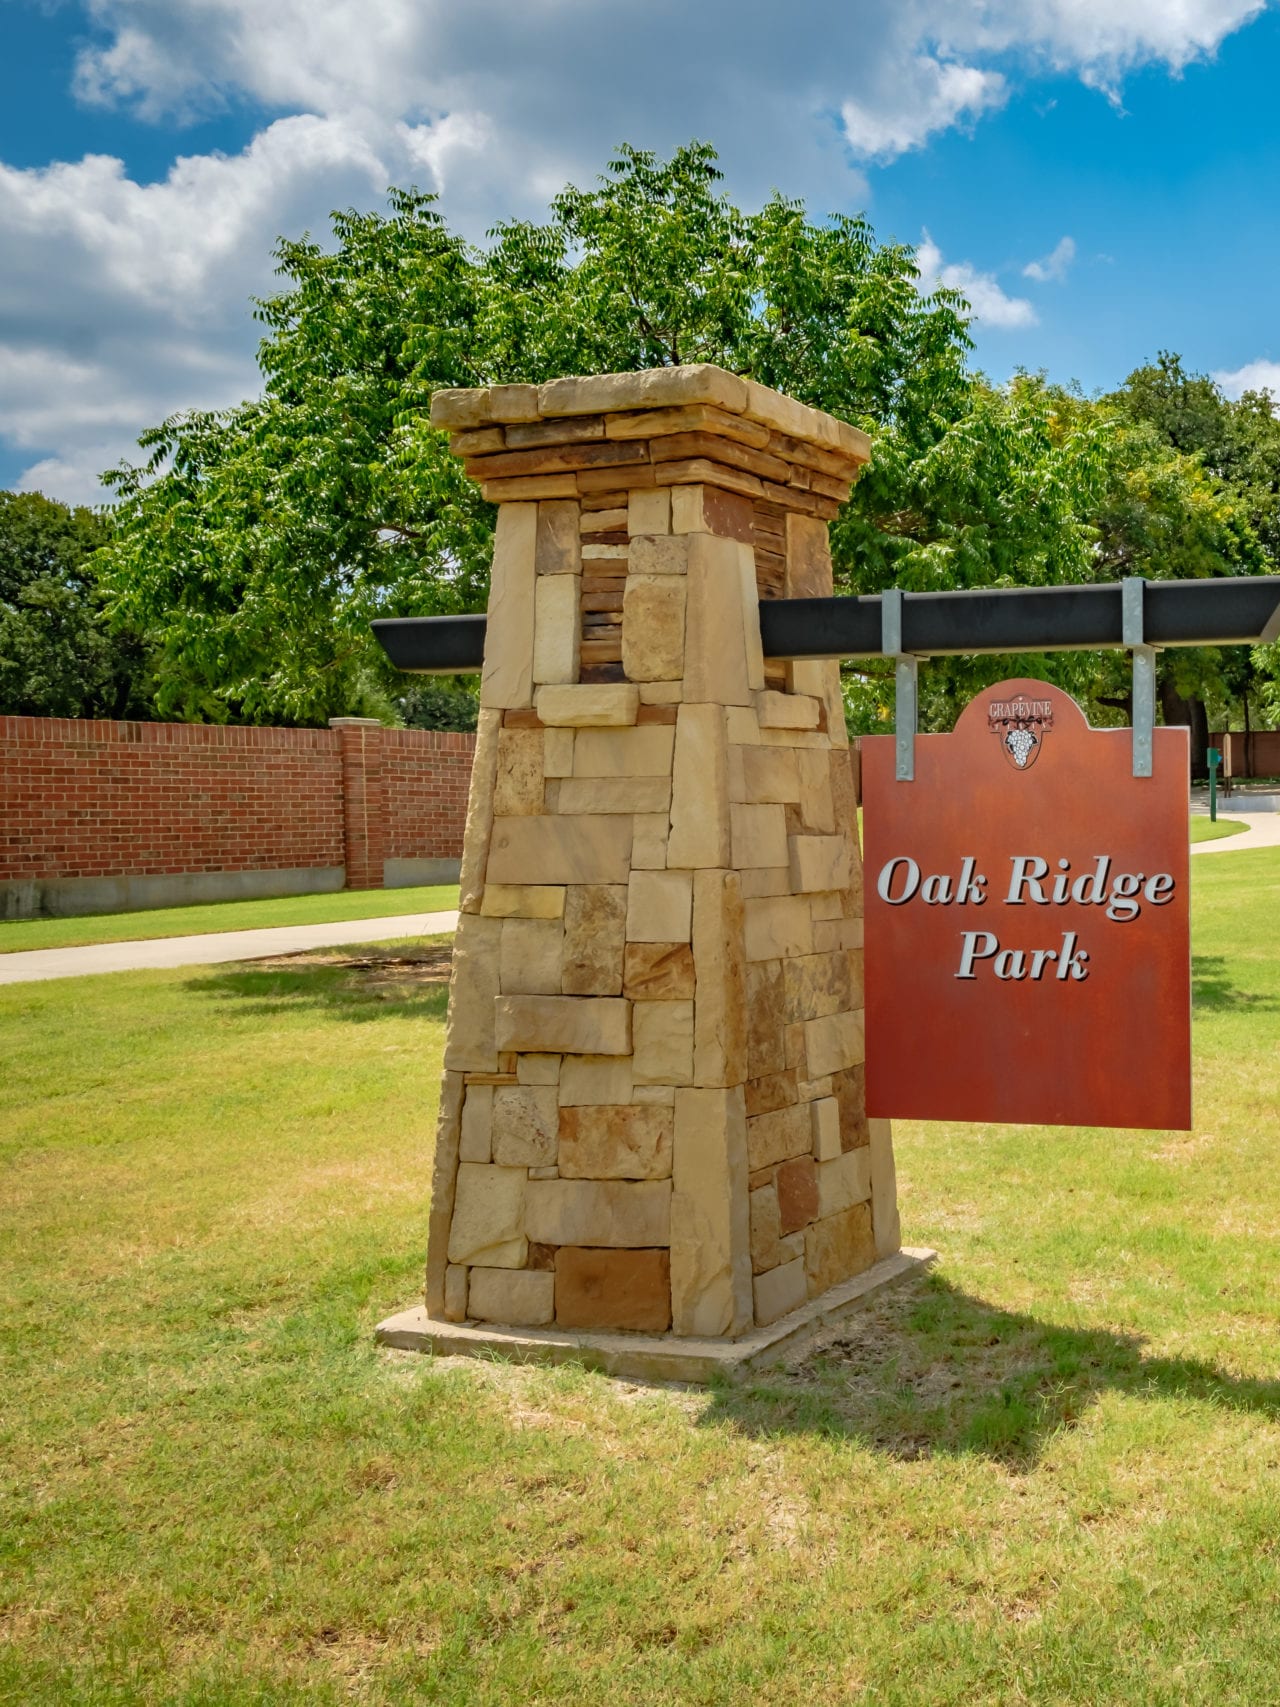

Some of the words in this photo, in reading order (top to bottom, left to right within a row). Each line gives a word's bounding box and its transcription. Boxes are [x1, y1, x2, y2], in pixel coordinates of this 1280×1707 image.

[989, 701, 1052, 717] GRAPEVINE
[876, 856, 988, 905] Oak
[1003, 855, 1176, 922] Ridge
[954, 931, 1090, 981] Park
